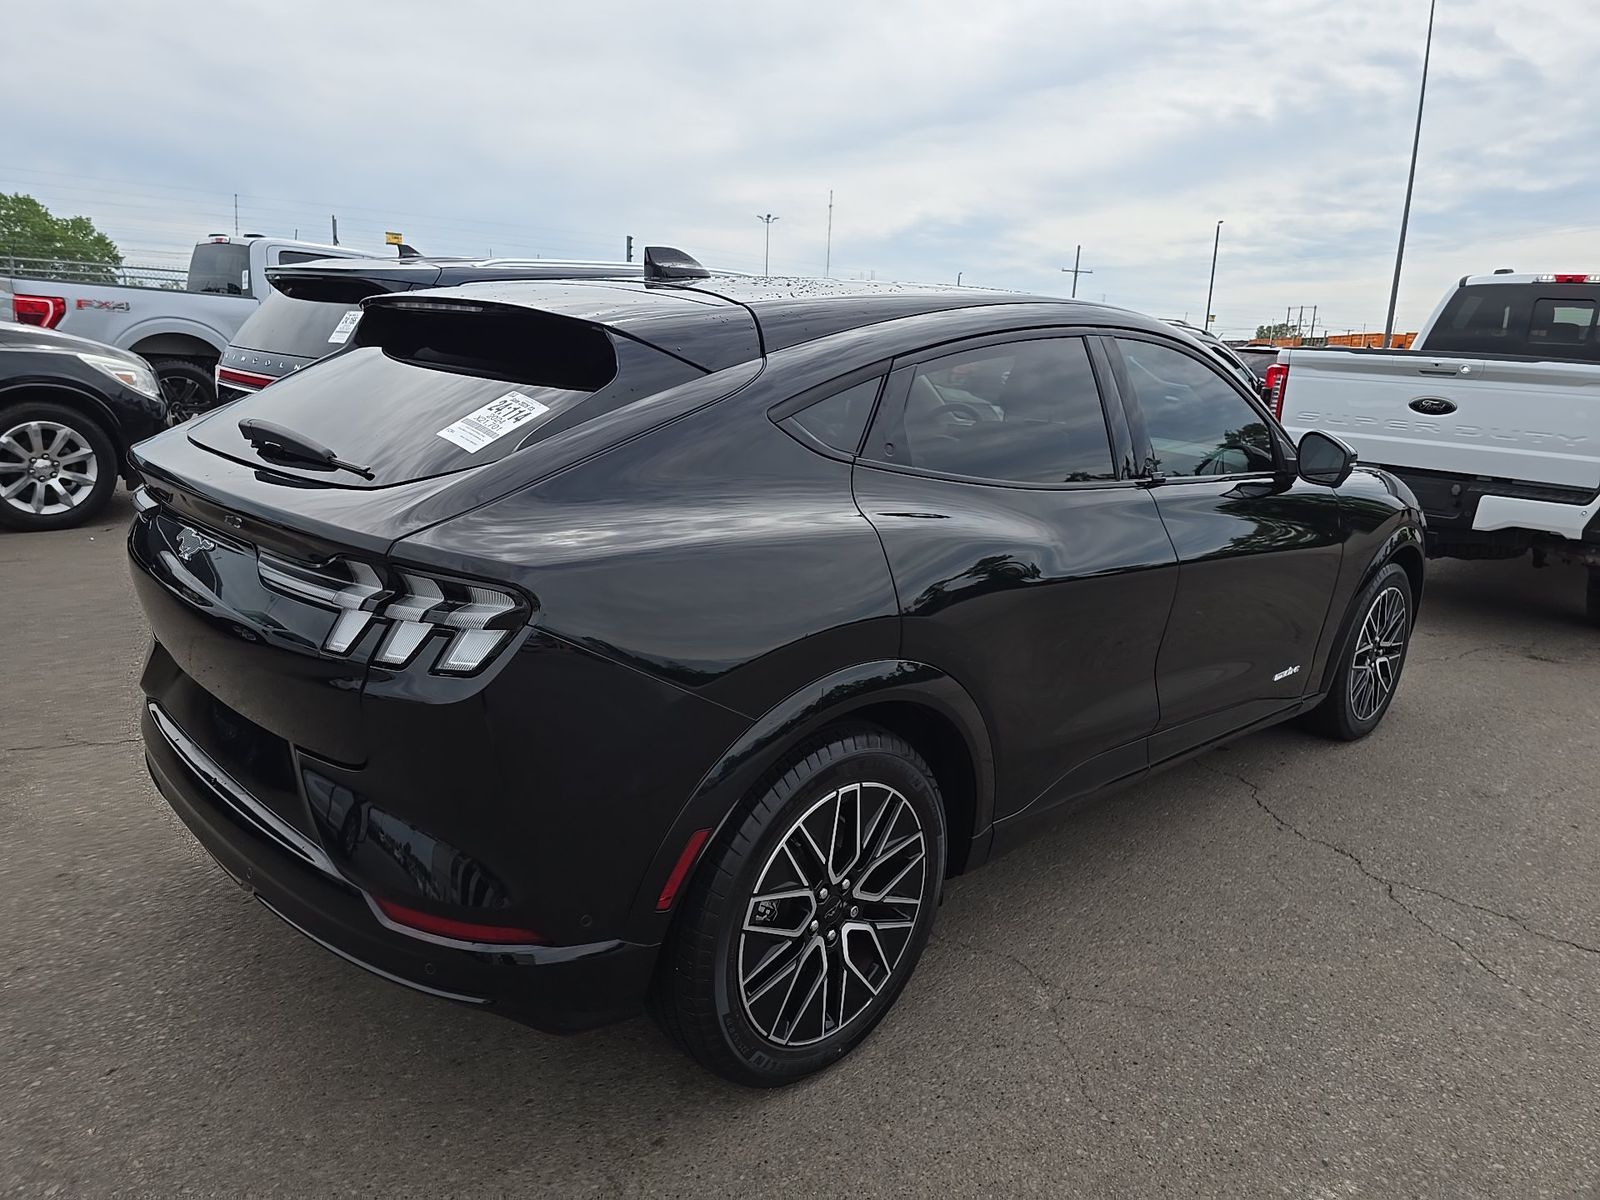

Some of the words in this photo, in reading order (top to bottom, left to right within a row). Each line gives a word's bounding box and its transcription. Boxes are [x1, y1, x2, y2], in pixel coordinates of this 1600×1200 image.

[75, 299, 131, 313] FX4
[225, 353, 301, 371] LINCOLN
[487, 399, 532, 424] 24:114
[1296, 410, 1442, 435] SUPER
[1454, 423, 1589, 447] DUTY
